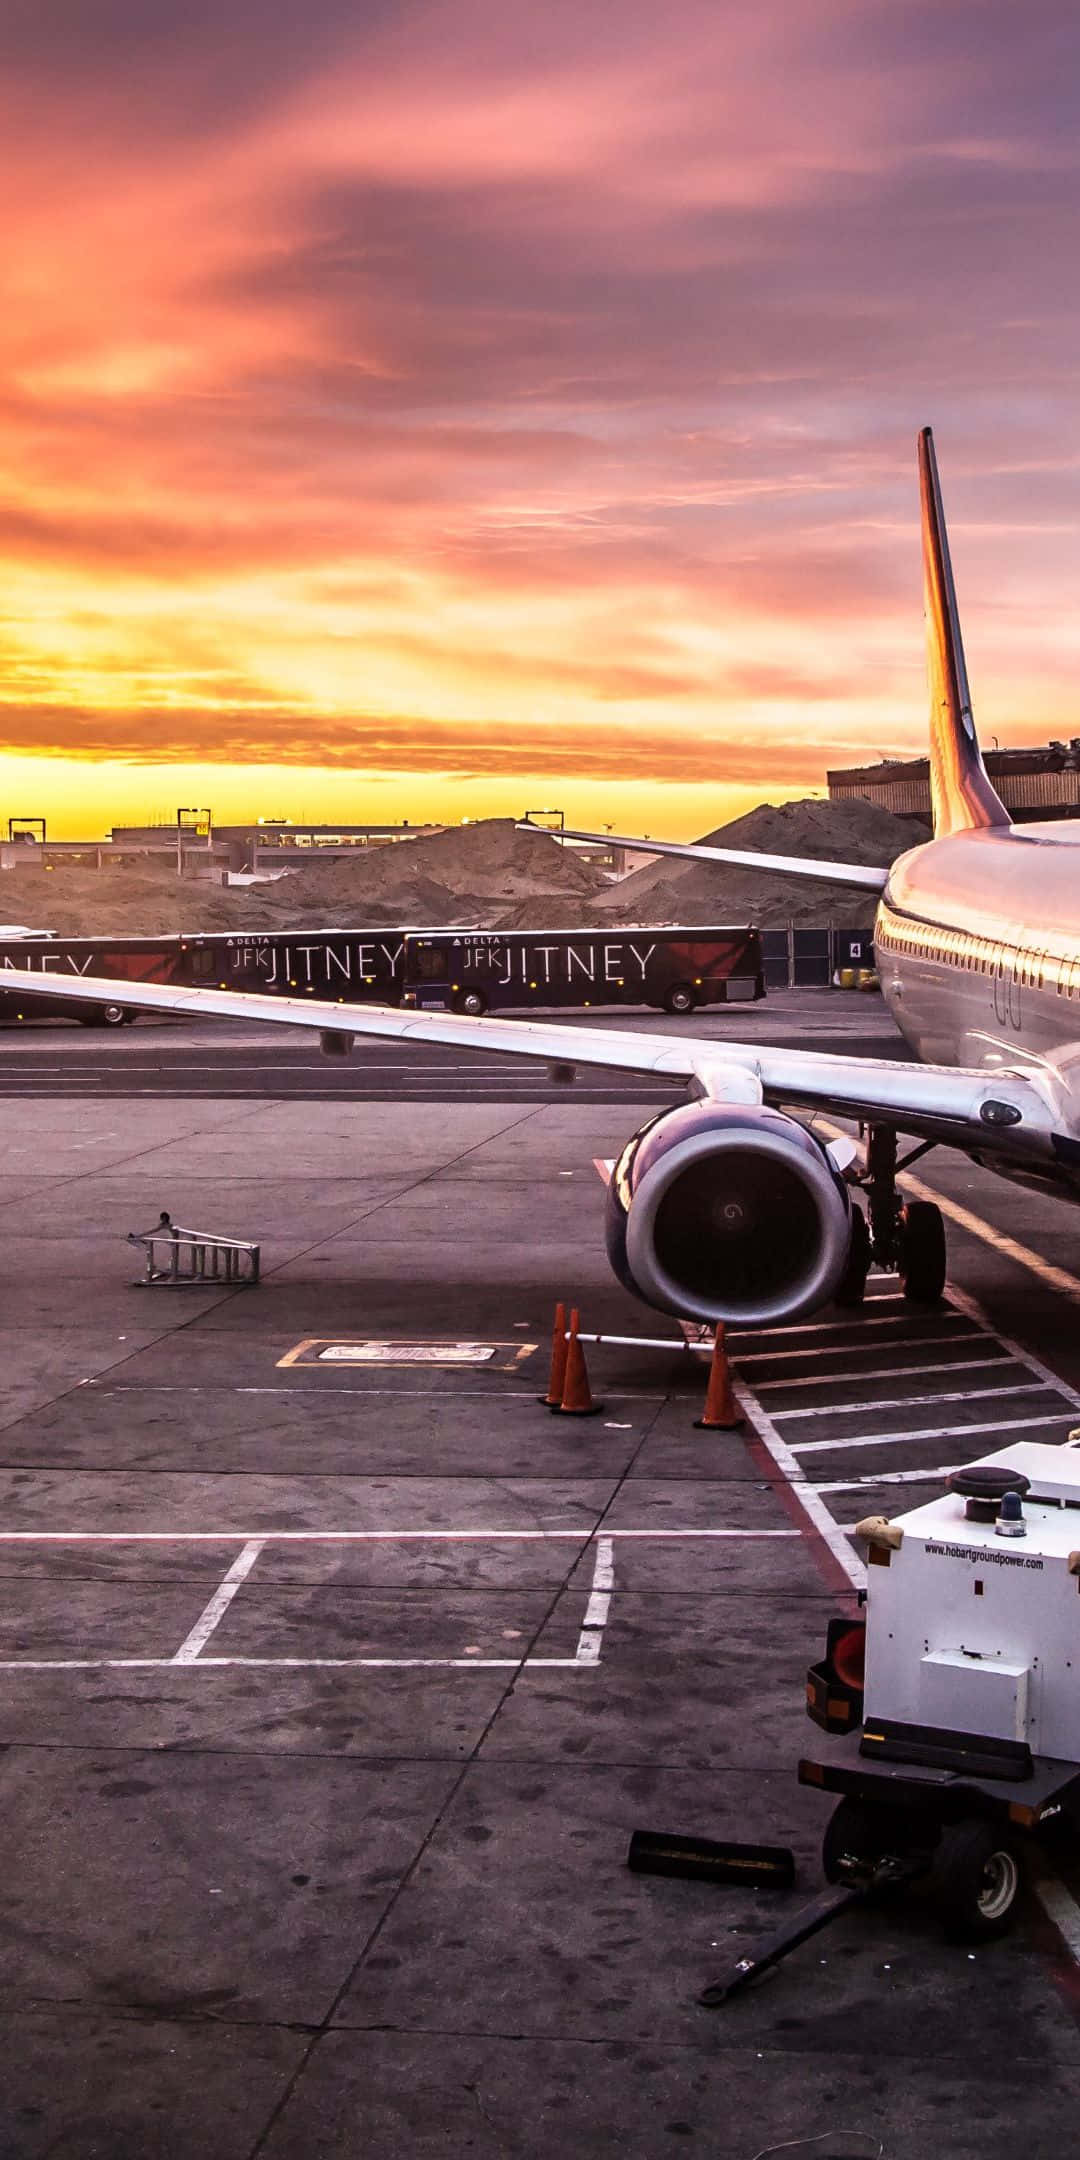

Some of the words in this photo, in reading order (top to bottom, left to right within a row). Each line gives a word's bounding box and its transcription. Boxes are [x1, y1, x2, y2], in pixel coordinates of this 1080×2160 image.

[237, 937, 270, 945] DELTA
[464, 936, 501, 945] DELTA
[852, 944, 860, 956] 4
[233, 948, 268, 968] JFK
[265, 944, 404, 982] JITNEY
[463, 948, 503, 968] JFK
[499, 944, 657, 984] JITNEY
[924, 1543, 1044, 1570] www.hobartgroundpower.com
